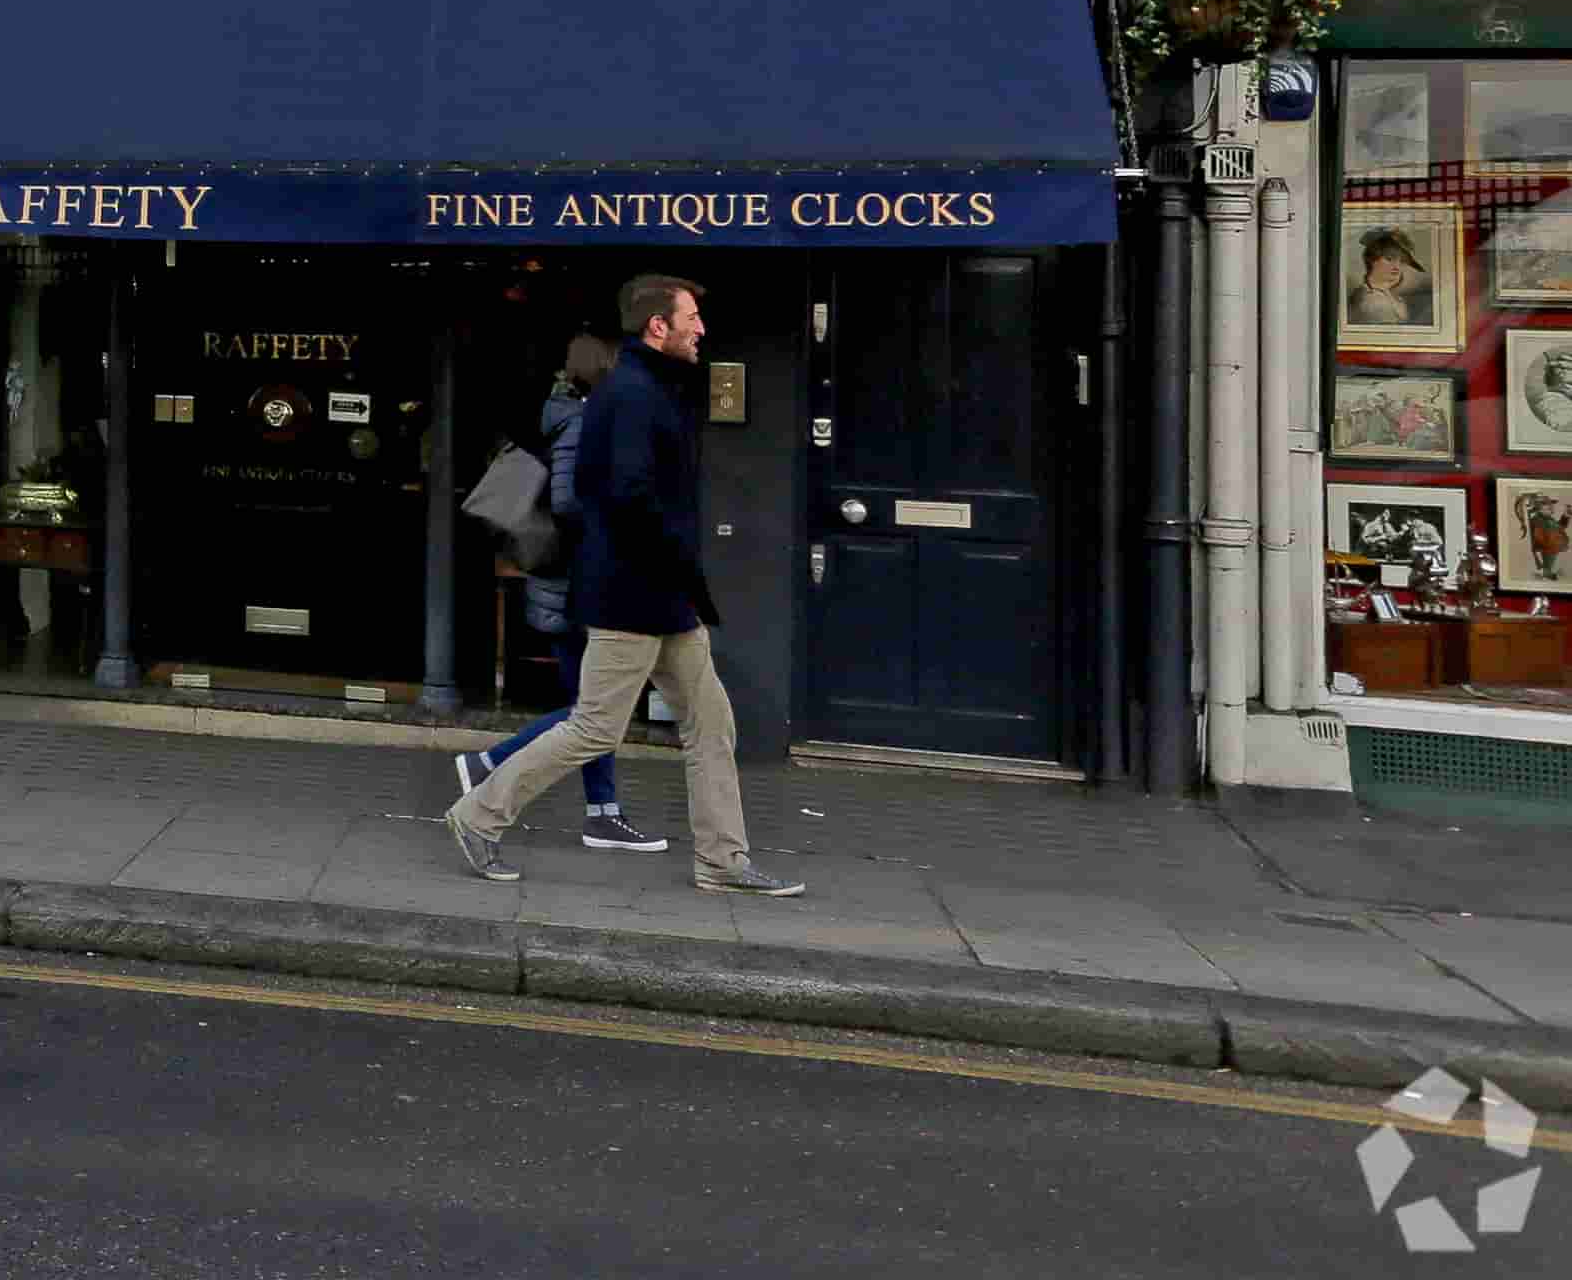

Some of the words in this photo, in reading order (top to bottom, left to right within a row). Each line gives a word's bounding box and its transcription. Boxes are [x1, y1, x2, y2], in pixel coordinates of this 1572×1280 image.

[426, 193, 535, 226] FINE
[554, 193, 771, 235] ANTIQUE
[790, 192, 996, 227] CLOCKS
[204, 331, 359, 361] RAFFETY
